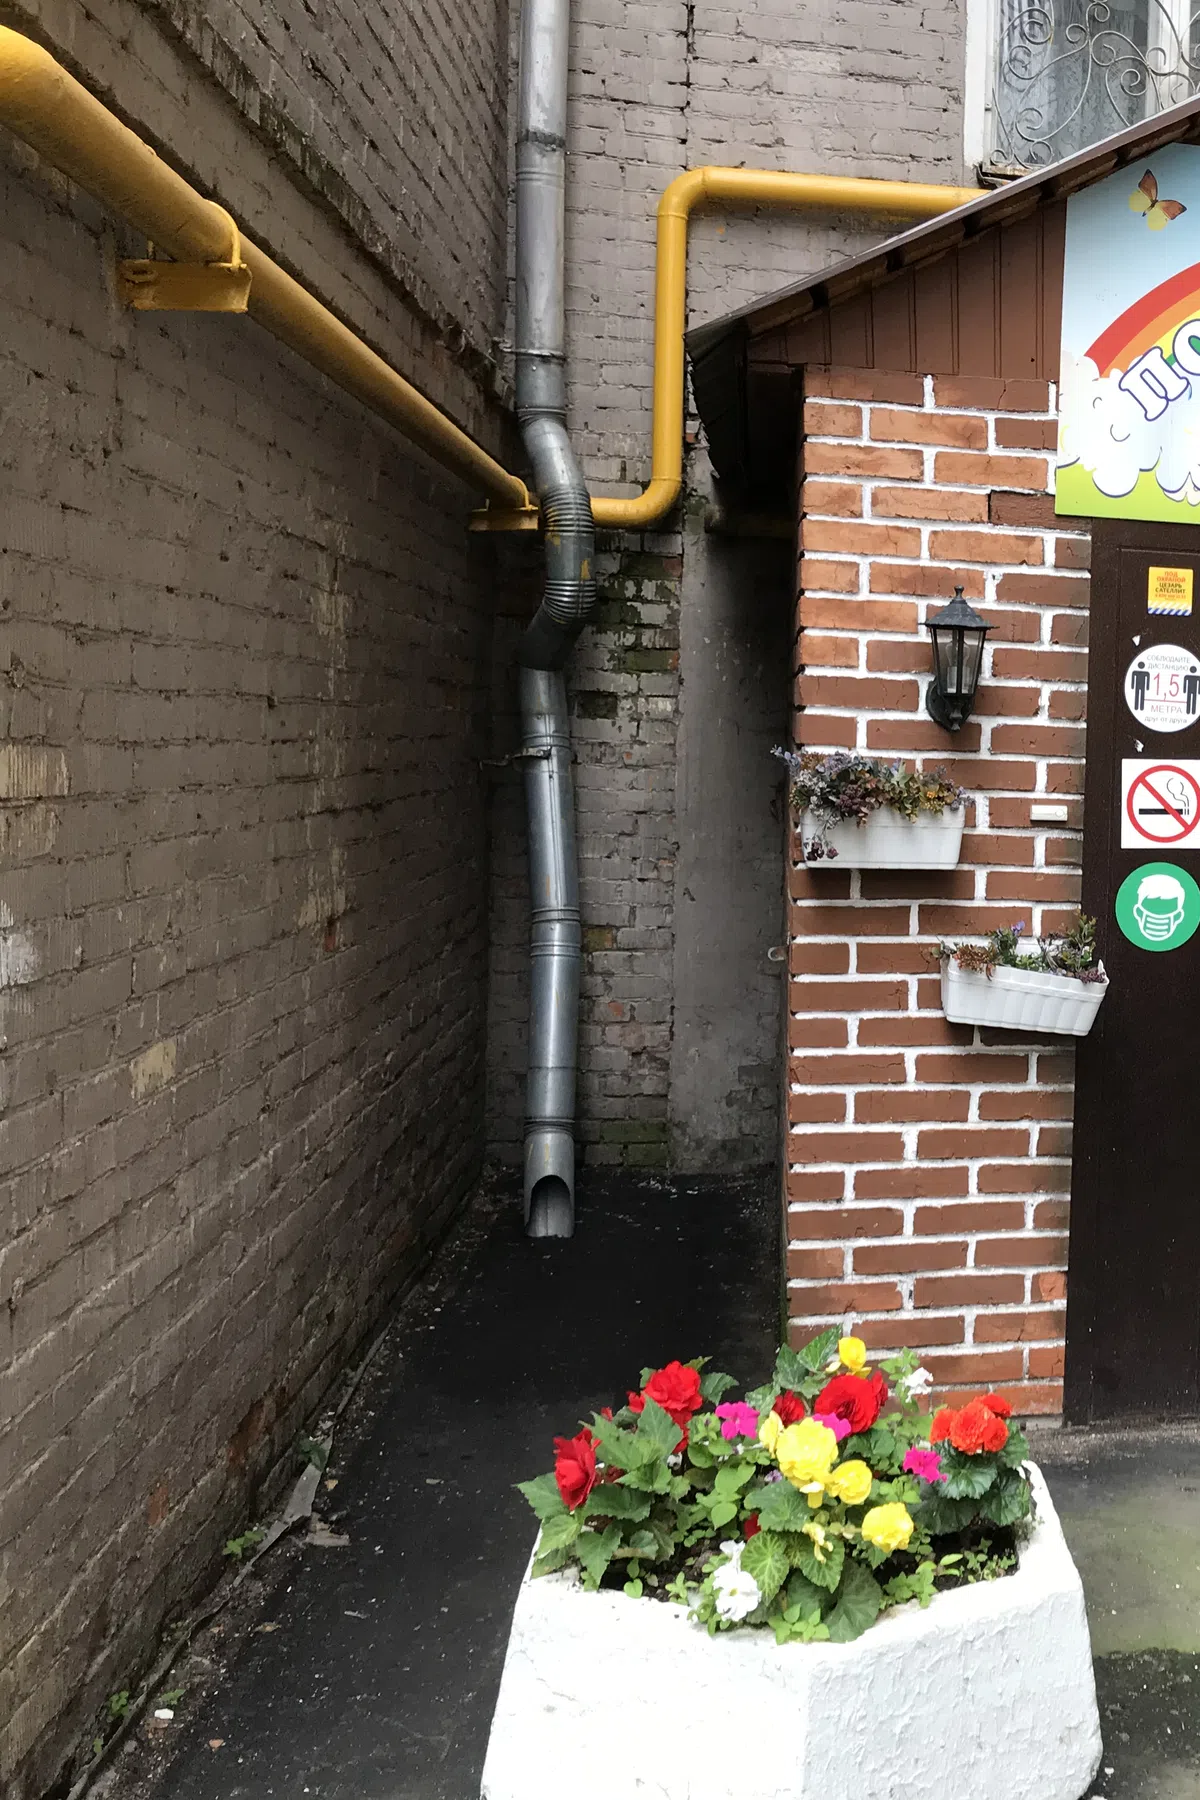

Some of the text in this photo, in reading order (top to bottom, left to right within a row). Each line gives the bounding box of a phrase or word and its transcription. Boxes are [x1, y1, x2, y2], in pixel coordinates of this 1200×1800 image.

[1146, 655, 1191, 664] СОБЛЮДАЙТЕ
[1147, 662, 1189, 671] ДИСТАНЦИЮ
[1153, 672, 1180, 701] 1,5
[1150, 704, 1183, 714] МЕТРА
